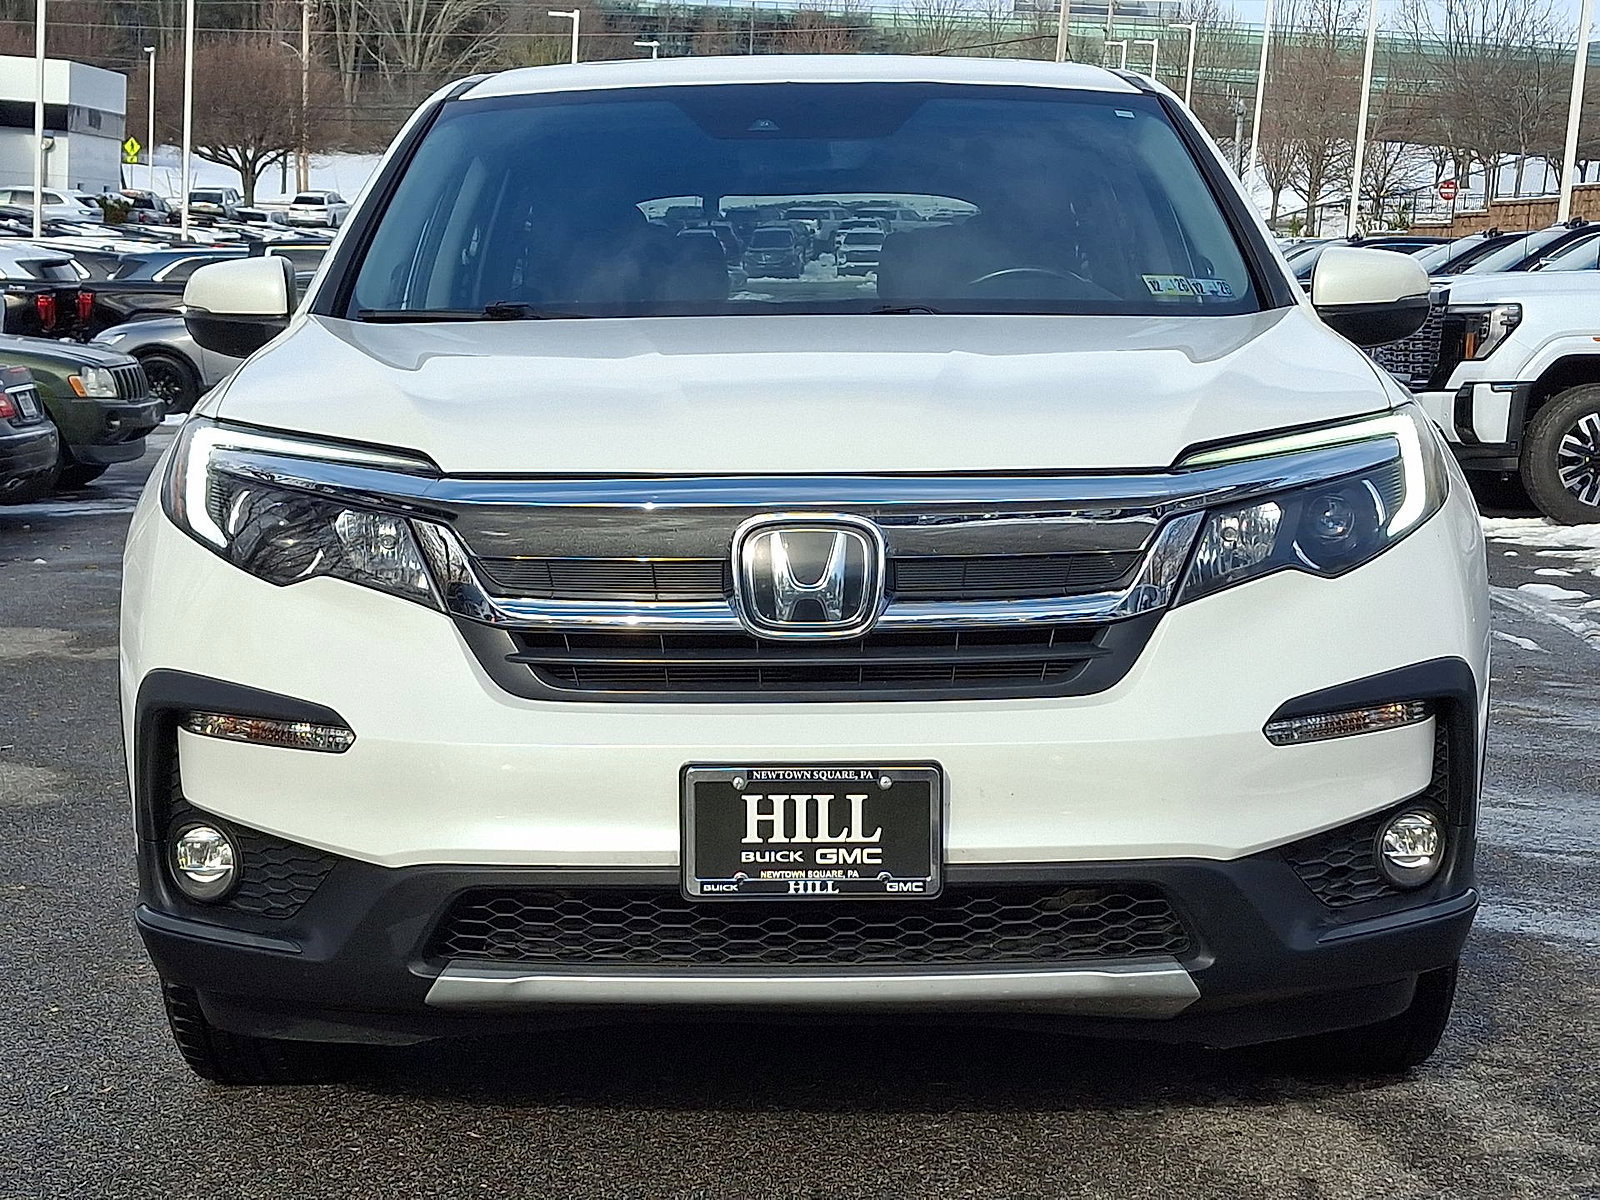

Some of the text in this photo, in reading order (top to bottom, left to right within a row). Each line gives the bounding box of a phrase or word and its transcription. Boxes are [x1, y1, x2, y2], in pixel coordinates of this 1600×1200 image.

[752, 770, 874, 781] NEWTOWN SQUARE, PA
[741, 794, 883, 844] HILL
[741, 848, 883, 865] BUICK GMC
[760, 869, 806, 879] NEWTOWN
[847, 869, 860, 879] PA
[703, 880, 924, 894] BUICK HILL GMC
